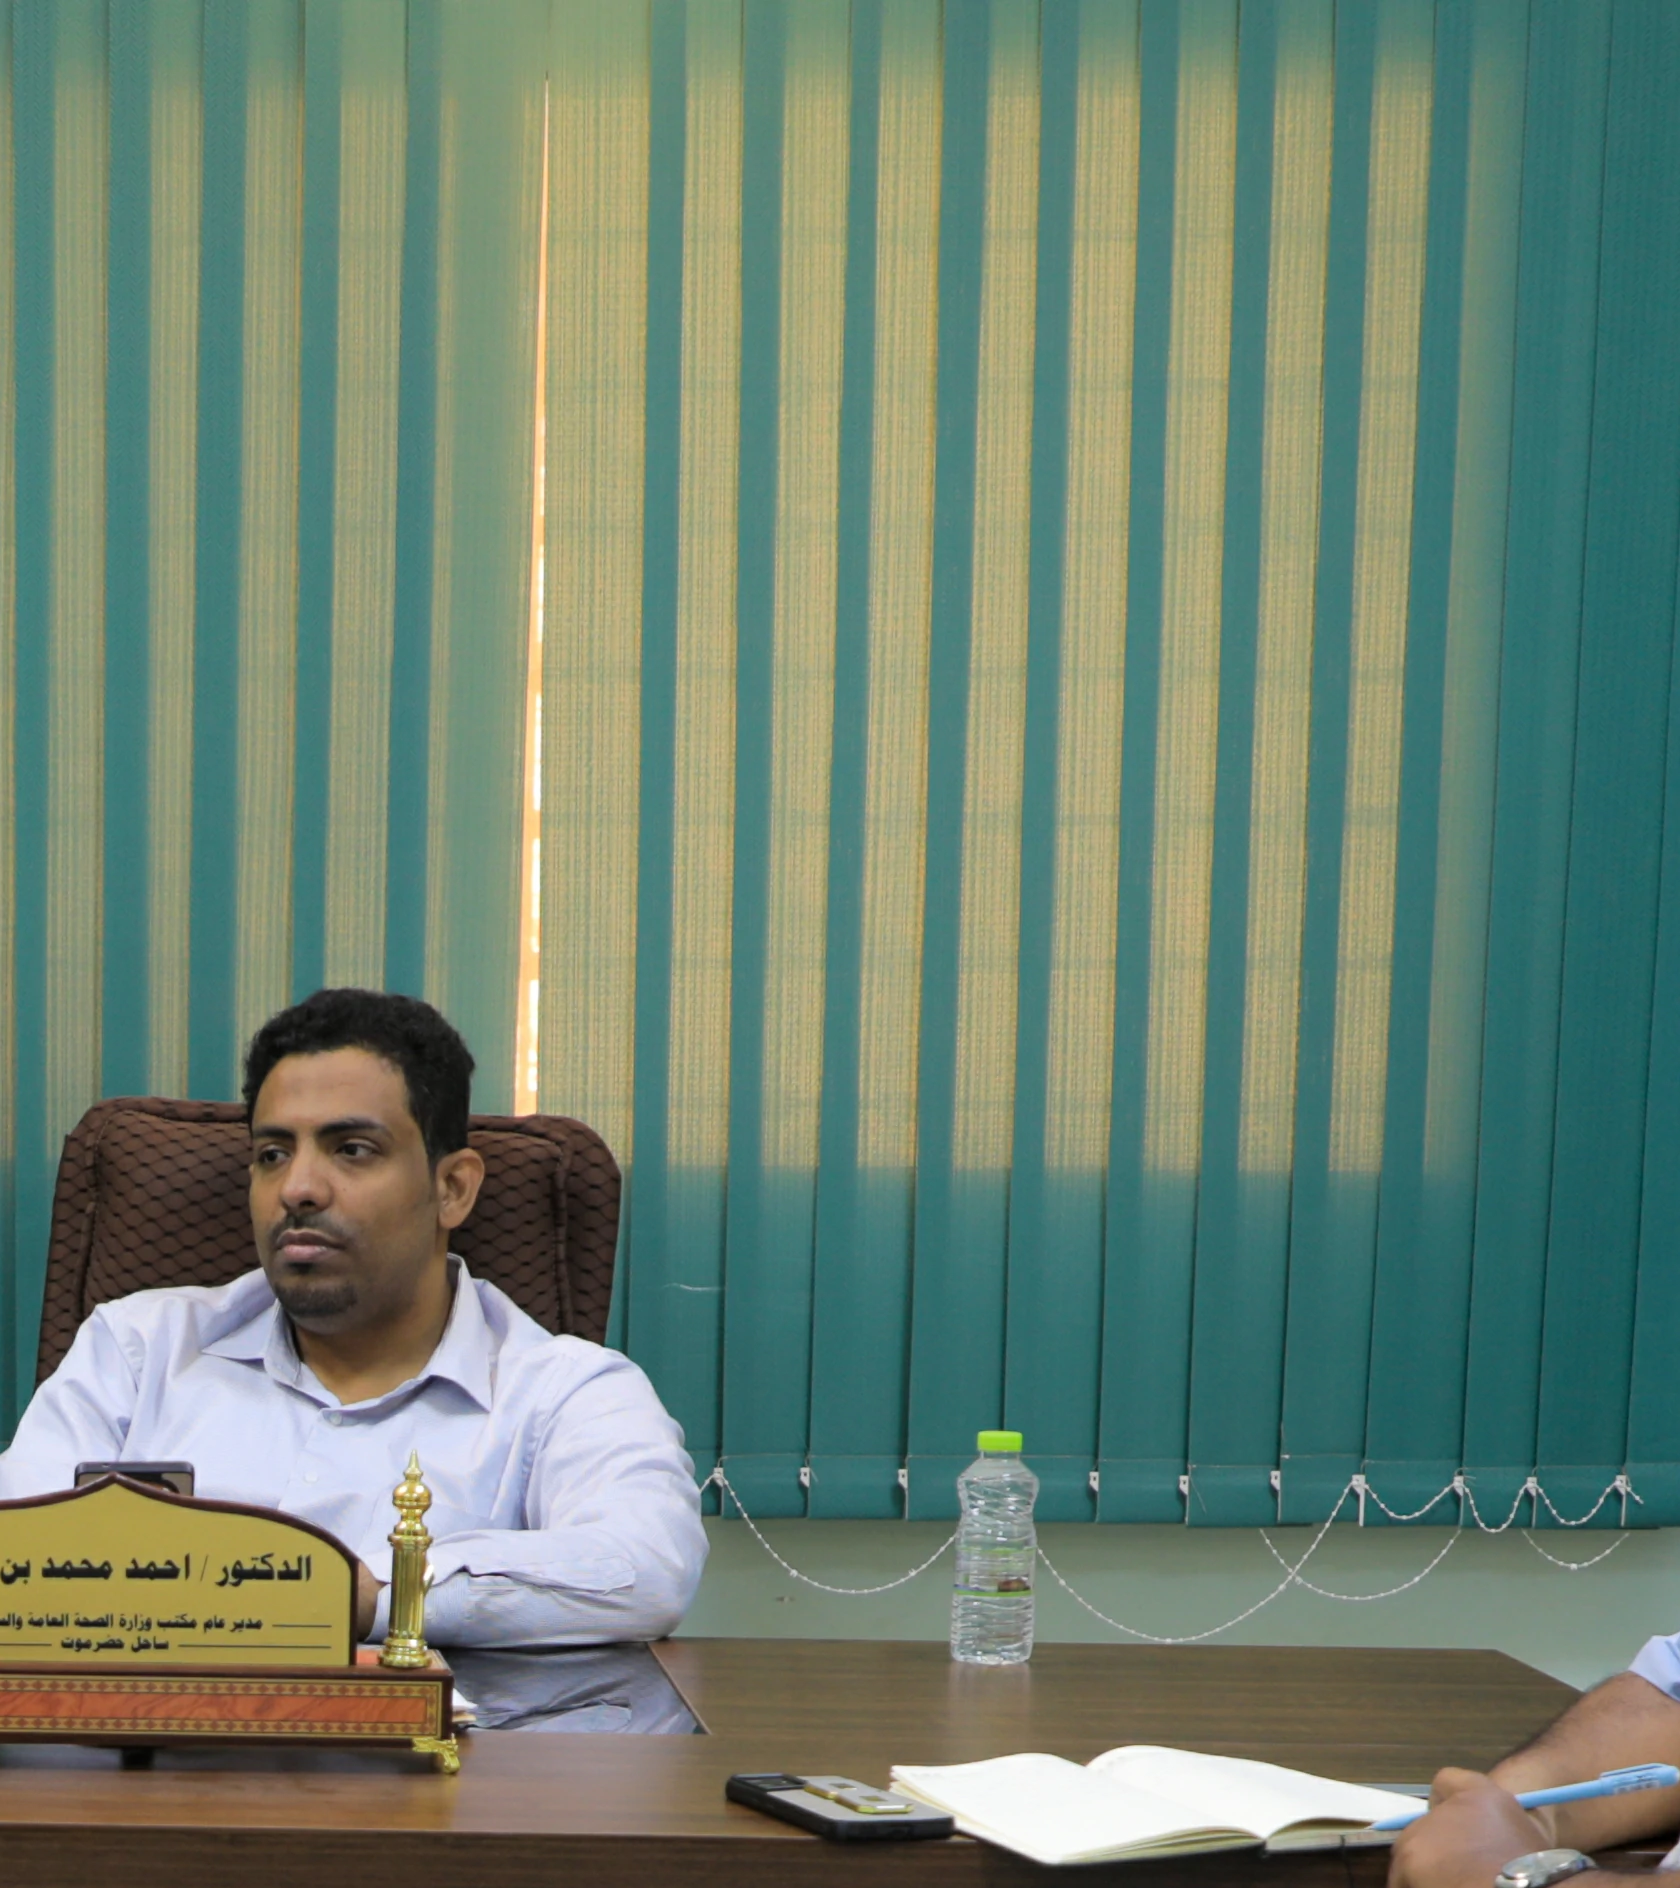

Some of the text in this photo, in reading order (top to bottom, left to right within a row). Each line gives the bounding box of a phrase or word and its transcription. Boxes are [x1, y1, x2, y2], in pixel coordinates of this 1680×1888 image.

[0, 1557, 31, 1585] بن
[42, 1556, 113, 1579] محمد
[125, 1553, 190, 1580] احمد
[214, 1553, 311, 1586] الدكتور
[28, 1611, 69, 1628] العامة
[74, 1612, 114, 1628] الصحة
[119, 1614, 152, 1632] وزارة
[157, 1612, 197, 1632] مكتب
[203, 1617, 225, 1634] عام
[230, 1617, 264, 1632] مدير
[61, 1636, 169, 1653] ساحل حضرموت
